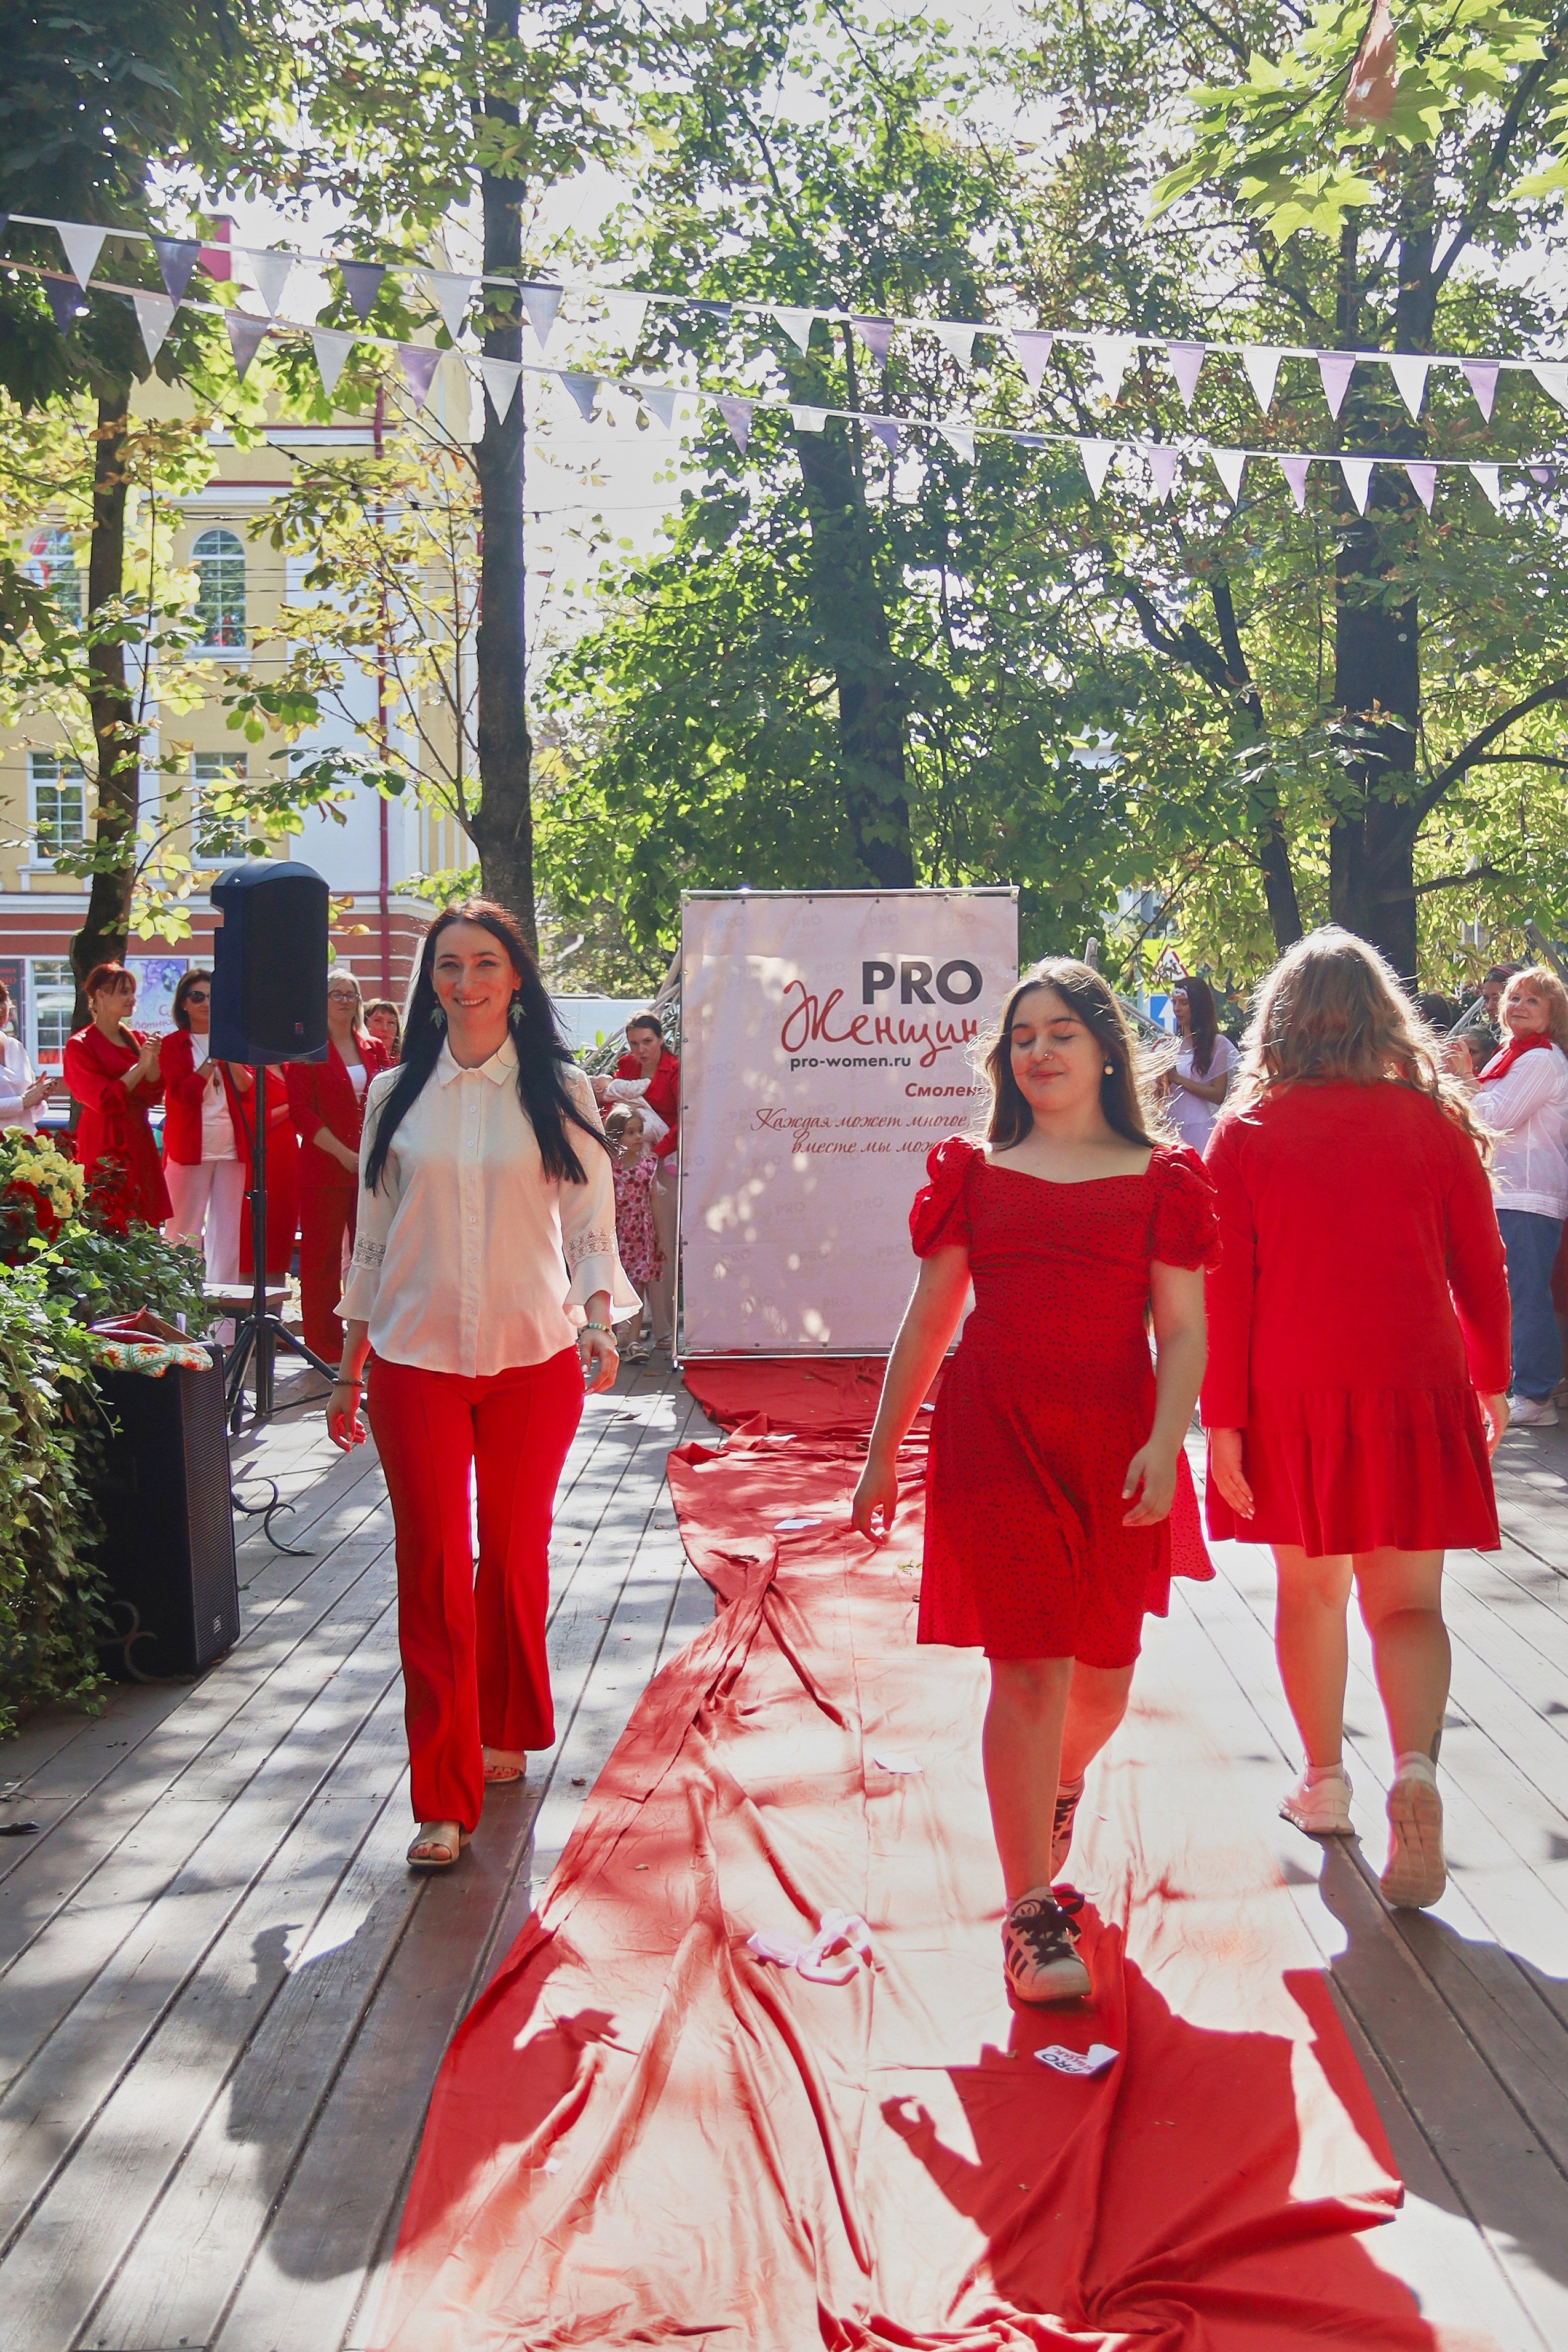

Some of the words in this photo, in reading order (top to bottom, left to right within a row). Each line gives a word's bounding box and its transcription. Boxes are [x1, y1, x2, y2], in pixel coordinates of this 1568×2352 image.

[862, 959, 983, 1005] PRO
[781, 980, 976, 1068] Женщин
[790, 1057, 911, 1072] pro-women.ru
[905, 1082, 991, 1098] Смолен
[751, 1108, 831, 1138] Каждая
[835, 1116, 902, 1128] может
[861, 1141, 892, 1153] мы
[896, 1141, 935, 1153] мож
[1042, 2054, 1083, 2072] PRO
